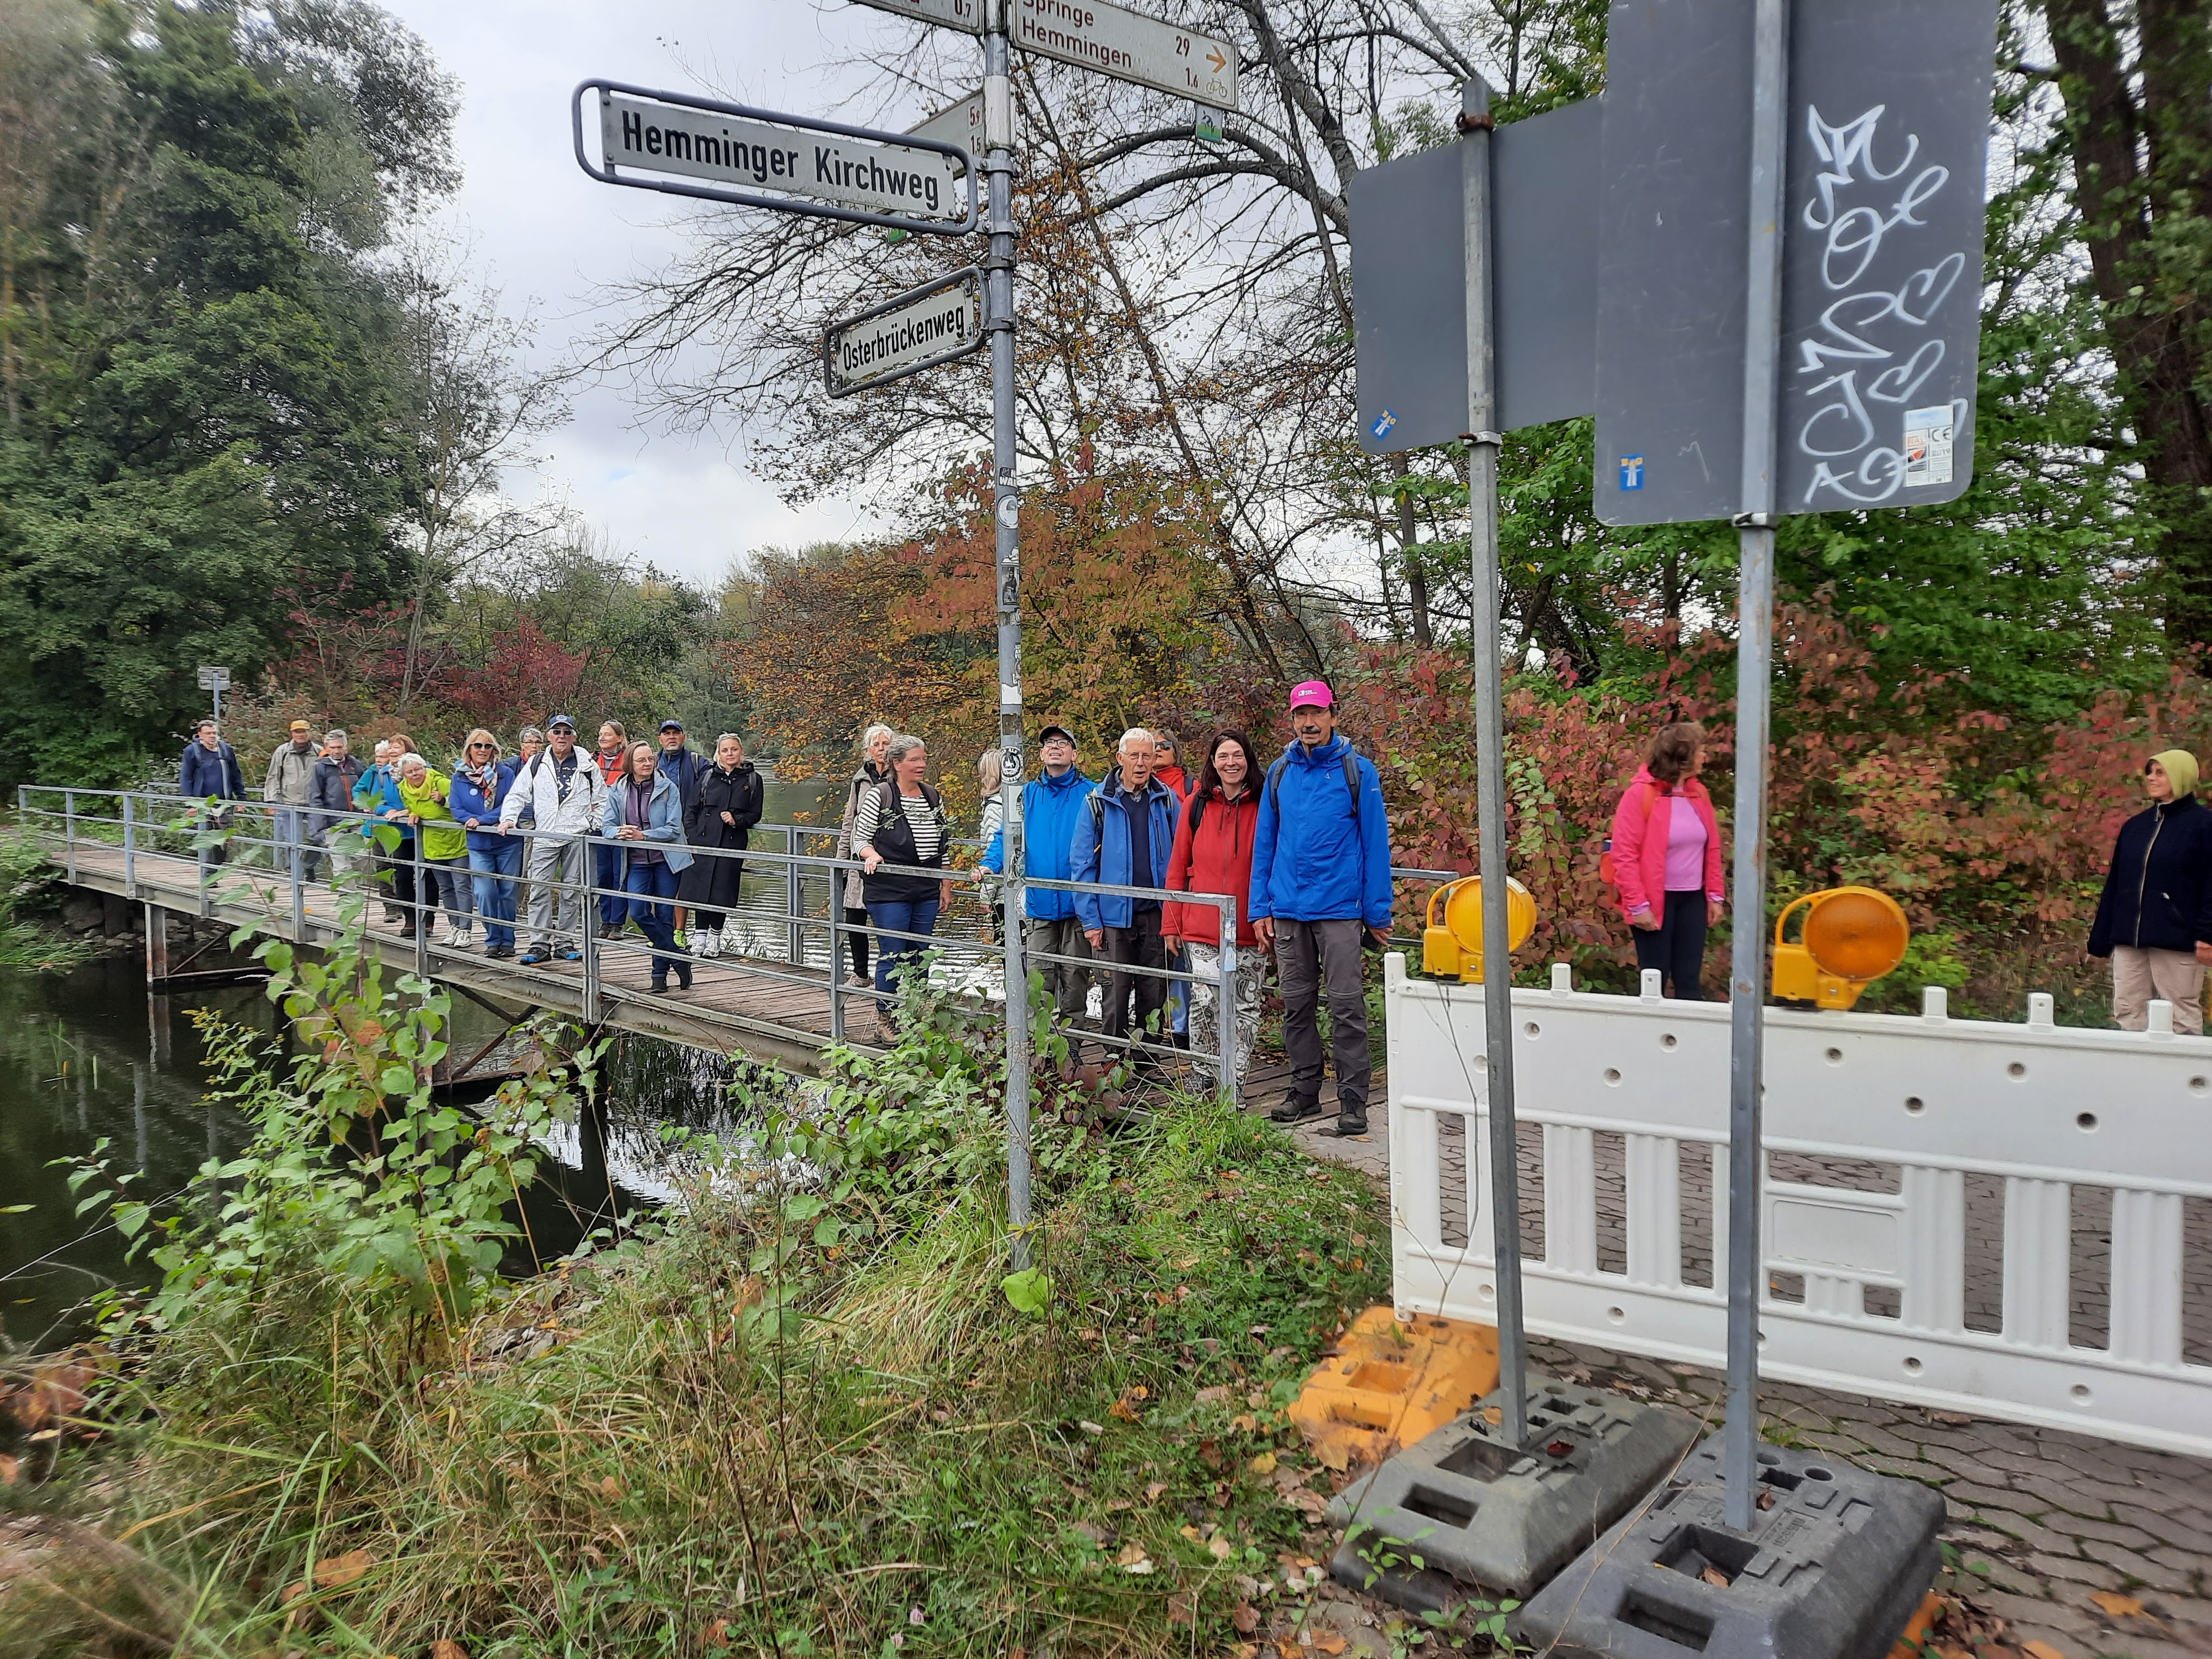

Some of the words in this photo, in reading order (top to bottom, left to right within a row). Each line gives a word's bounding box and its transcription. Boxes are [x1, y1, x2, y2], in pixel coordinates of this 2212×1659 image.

[1022, 15, 1131, 68] Hemmingen
[1186, 67, 1198, 89] 1.6
[1176, 35, 1190, 57] 29
[970, 106, 980, 127] 5.9
[623, 110, 799, 182] Hemminger
[815, 145, 938, 211] Kirchweg
[971, 134, 981, 155] 1.5
[843, 305, 964, 372] Osterbrückenweg
